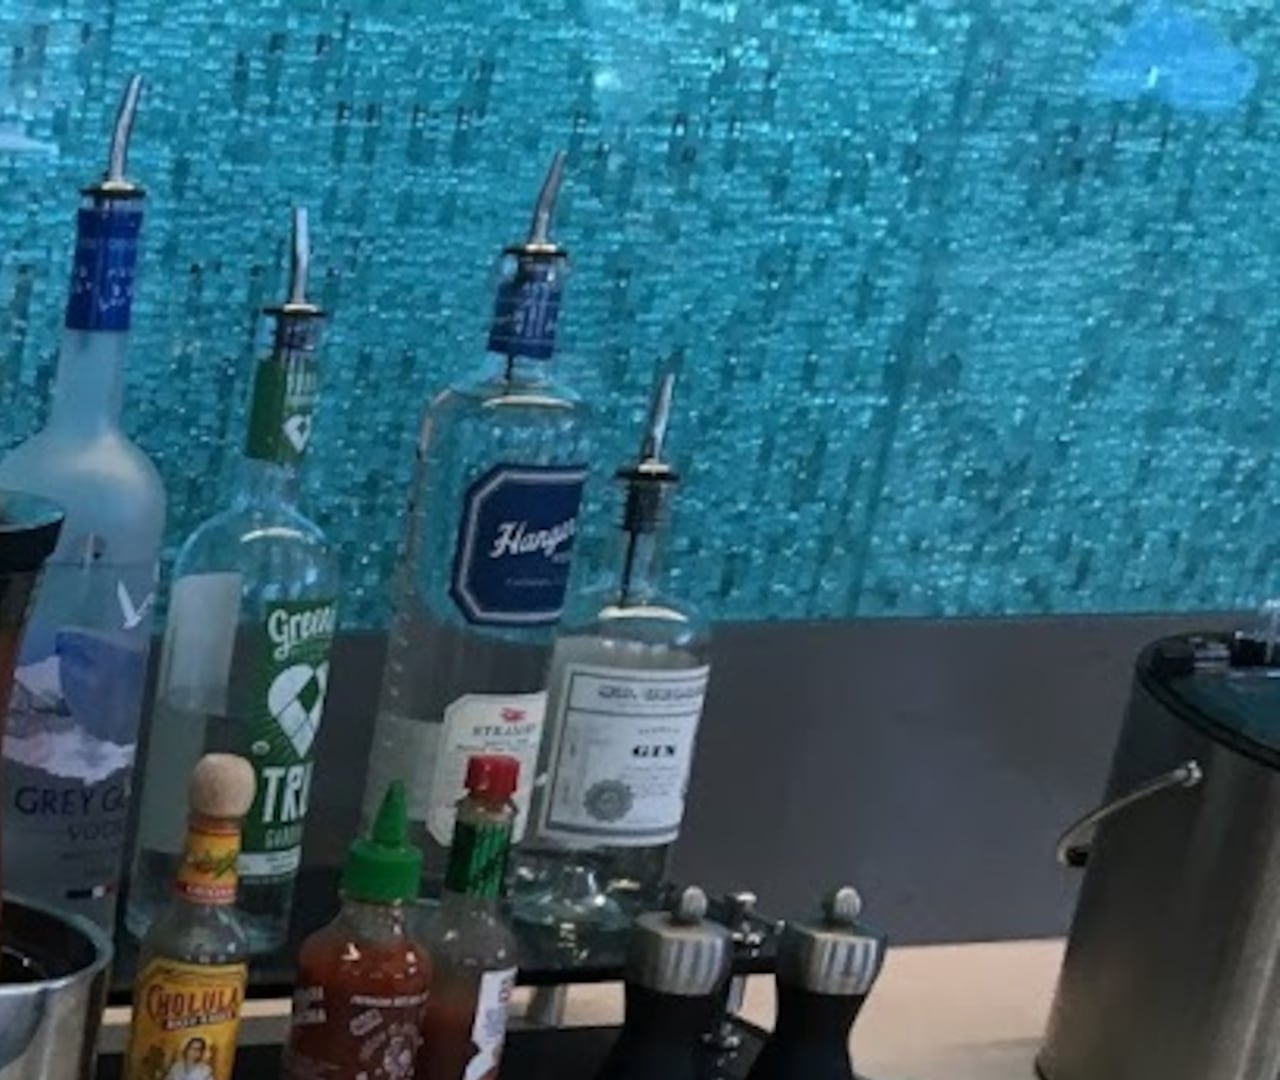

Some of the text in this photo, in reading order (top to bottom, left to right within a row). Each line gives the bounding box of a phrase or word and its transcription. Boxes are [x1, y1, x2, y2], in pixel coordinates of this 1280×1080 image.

[631, 744, 676, 758] GIN
[15, 785, 95, 815] GREY
[146, 983, 239, 1021] CHOLULA
